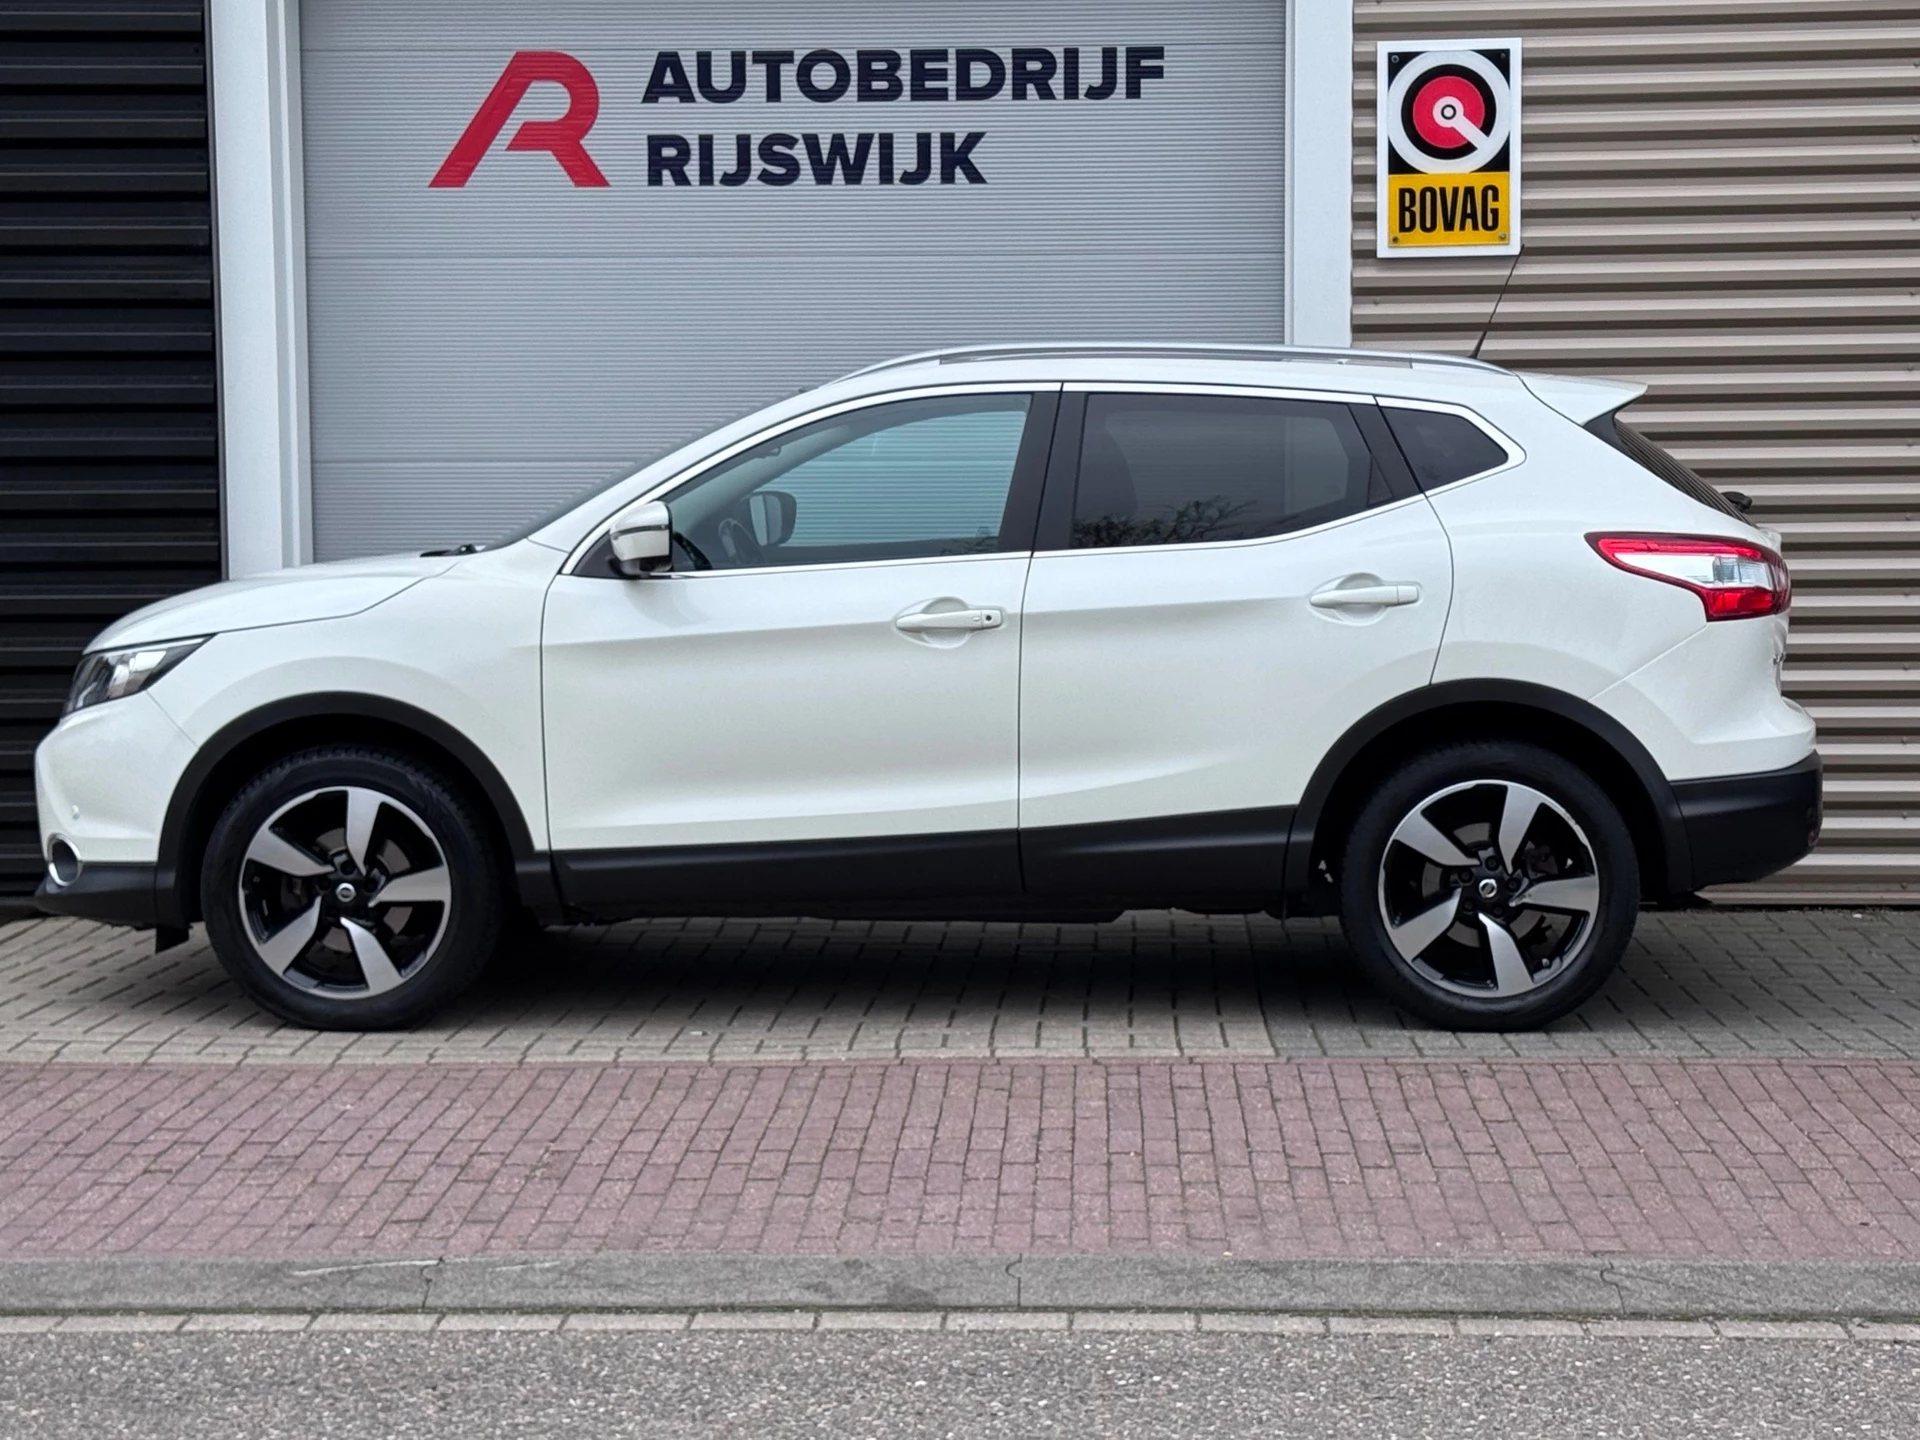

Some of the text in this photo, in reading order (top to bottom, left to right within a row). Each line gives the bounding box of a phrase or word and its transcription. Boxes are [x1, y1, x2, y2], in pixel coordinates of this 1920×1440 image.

[641, 46, 1165, 103] AUTOBEDRIJF
[647, 132, 988, 186] RIJSWIJK
[1398, 185, 1499, 233] BOVAG
